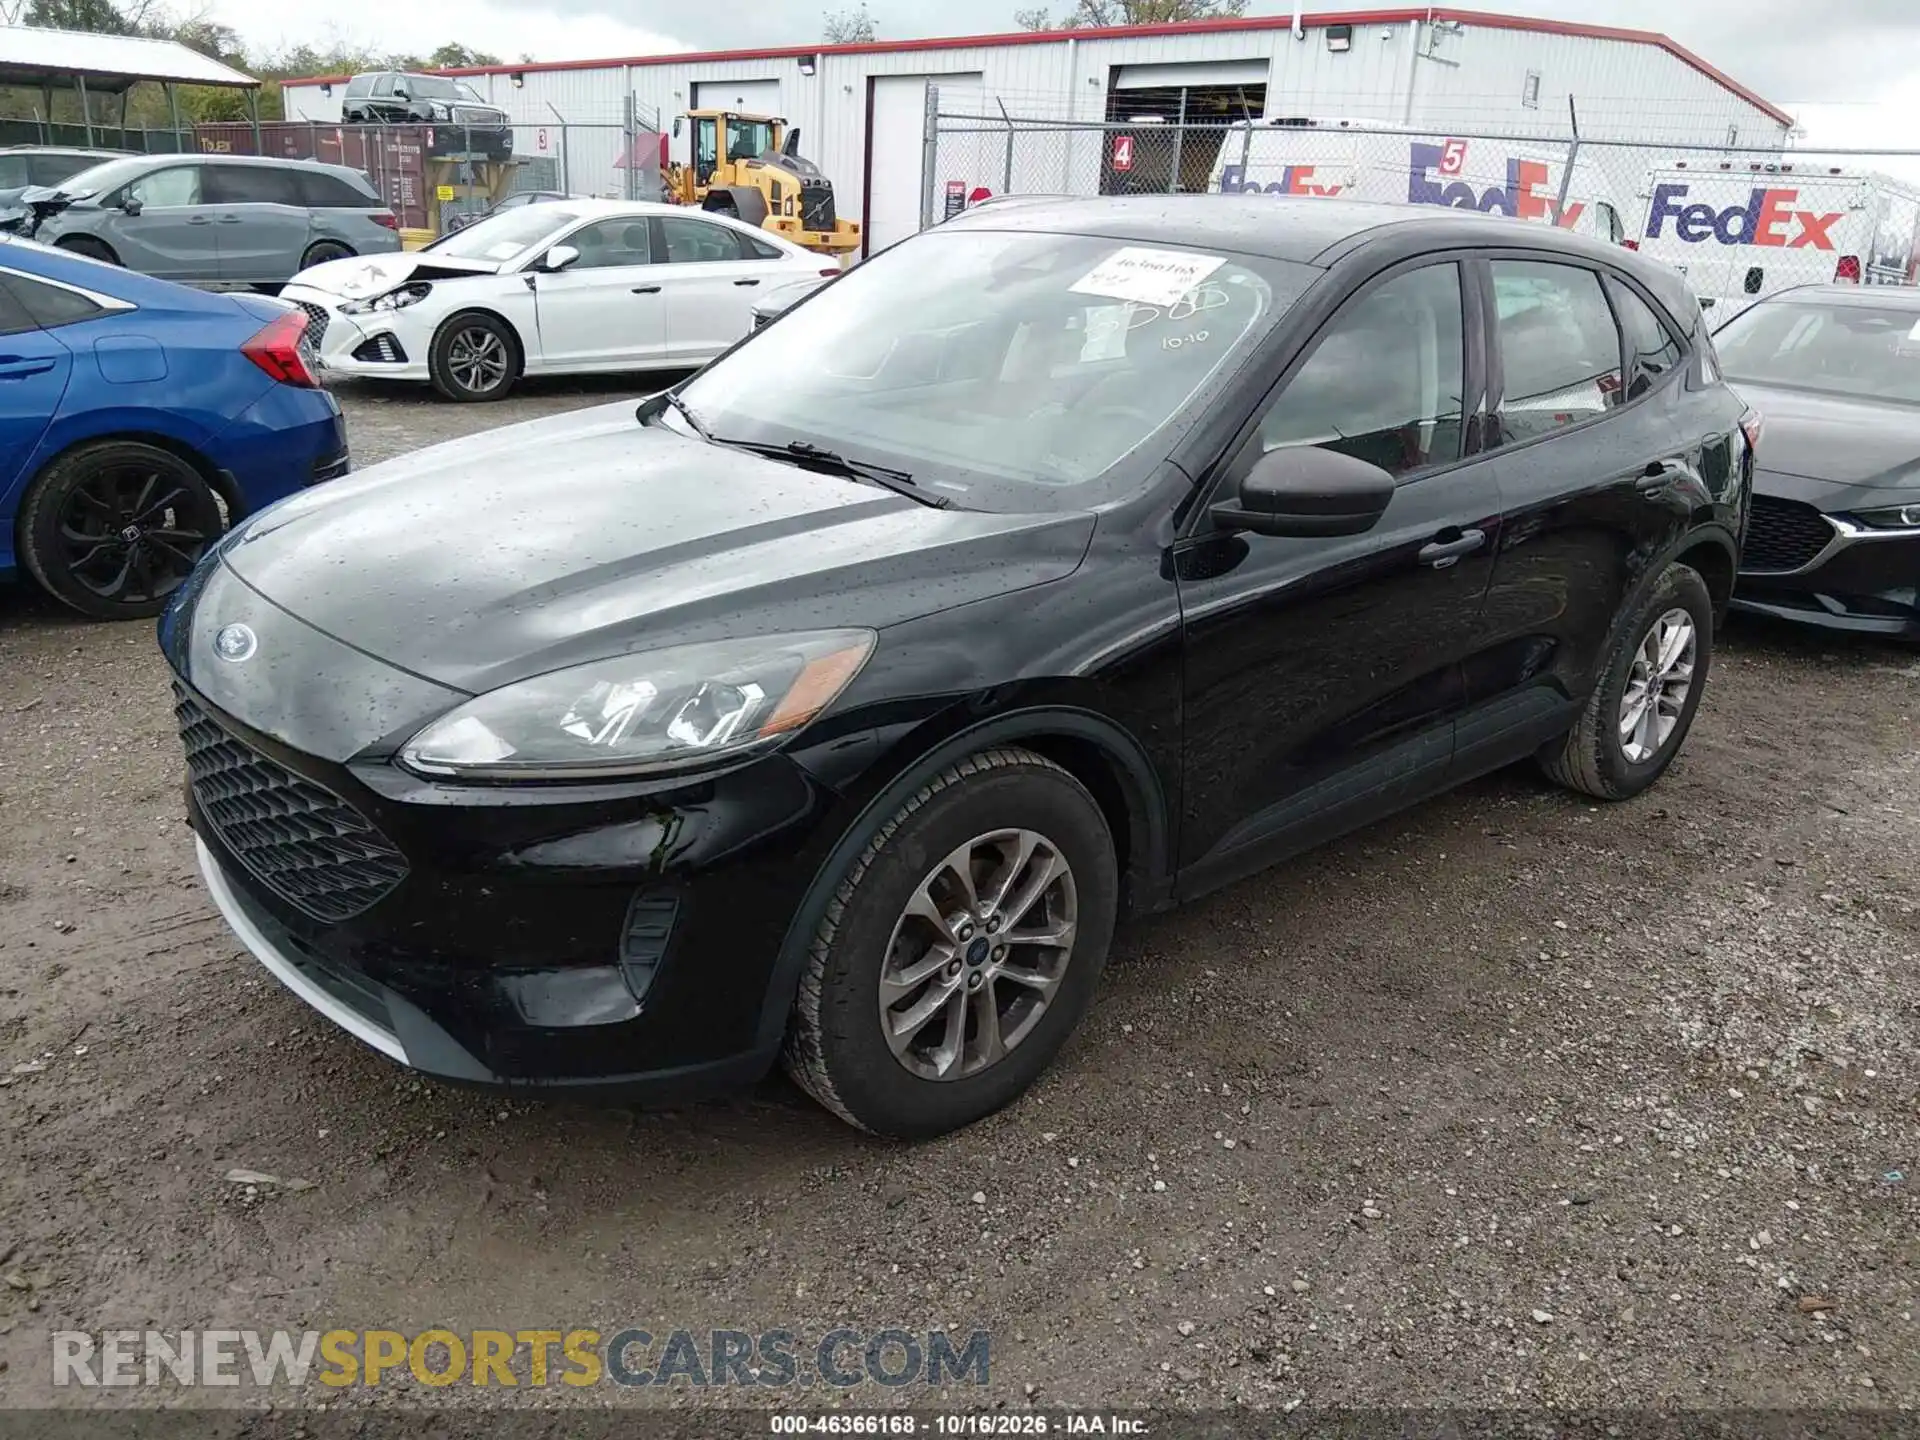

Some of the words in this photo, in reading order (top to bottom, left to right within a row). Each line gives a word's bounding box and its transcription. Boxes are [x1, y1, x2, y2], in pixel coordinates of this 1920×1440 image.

[1115, 140, 1129, 166] 4
[1443, 144, 1461, 171] 5
[1222, 165, 1341, 196] FdE
[1646, 183, 1845, 251] FedEx
